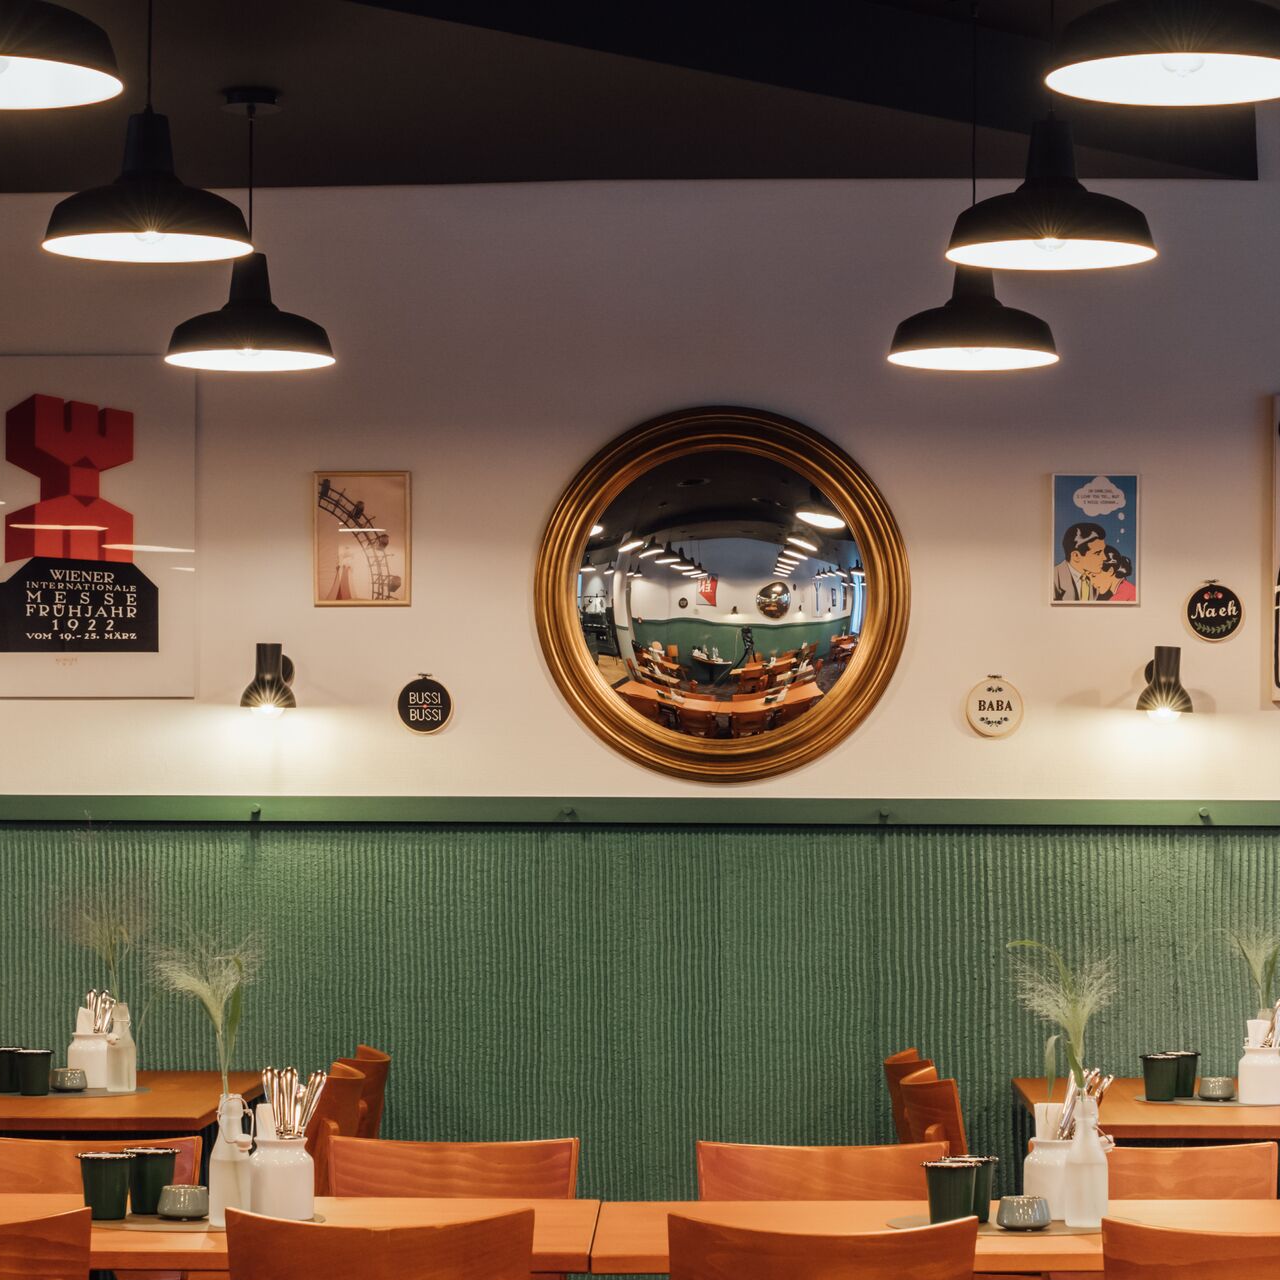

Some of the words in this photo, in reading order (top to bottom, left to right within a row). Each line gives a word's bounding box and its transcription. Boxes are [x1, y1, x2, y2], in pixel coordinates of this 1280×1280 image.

[49, 569, 115, 583] WIENER
[26, 581, 137, 592] INTERNATIONALE
[26, 590, 137, 606] MESSE
[52, 619, 115, 631] 1922
[26, 632, 53, 640] VOM
[104, 632, 137, 640] MÄRZ
[409, 691, 441, 704] BUSSI
[978, 699, 1013, 712] BABA
[409, 708, 442, 721] BUSSI
